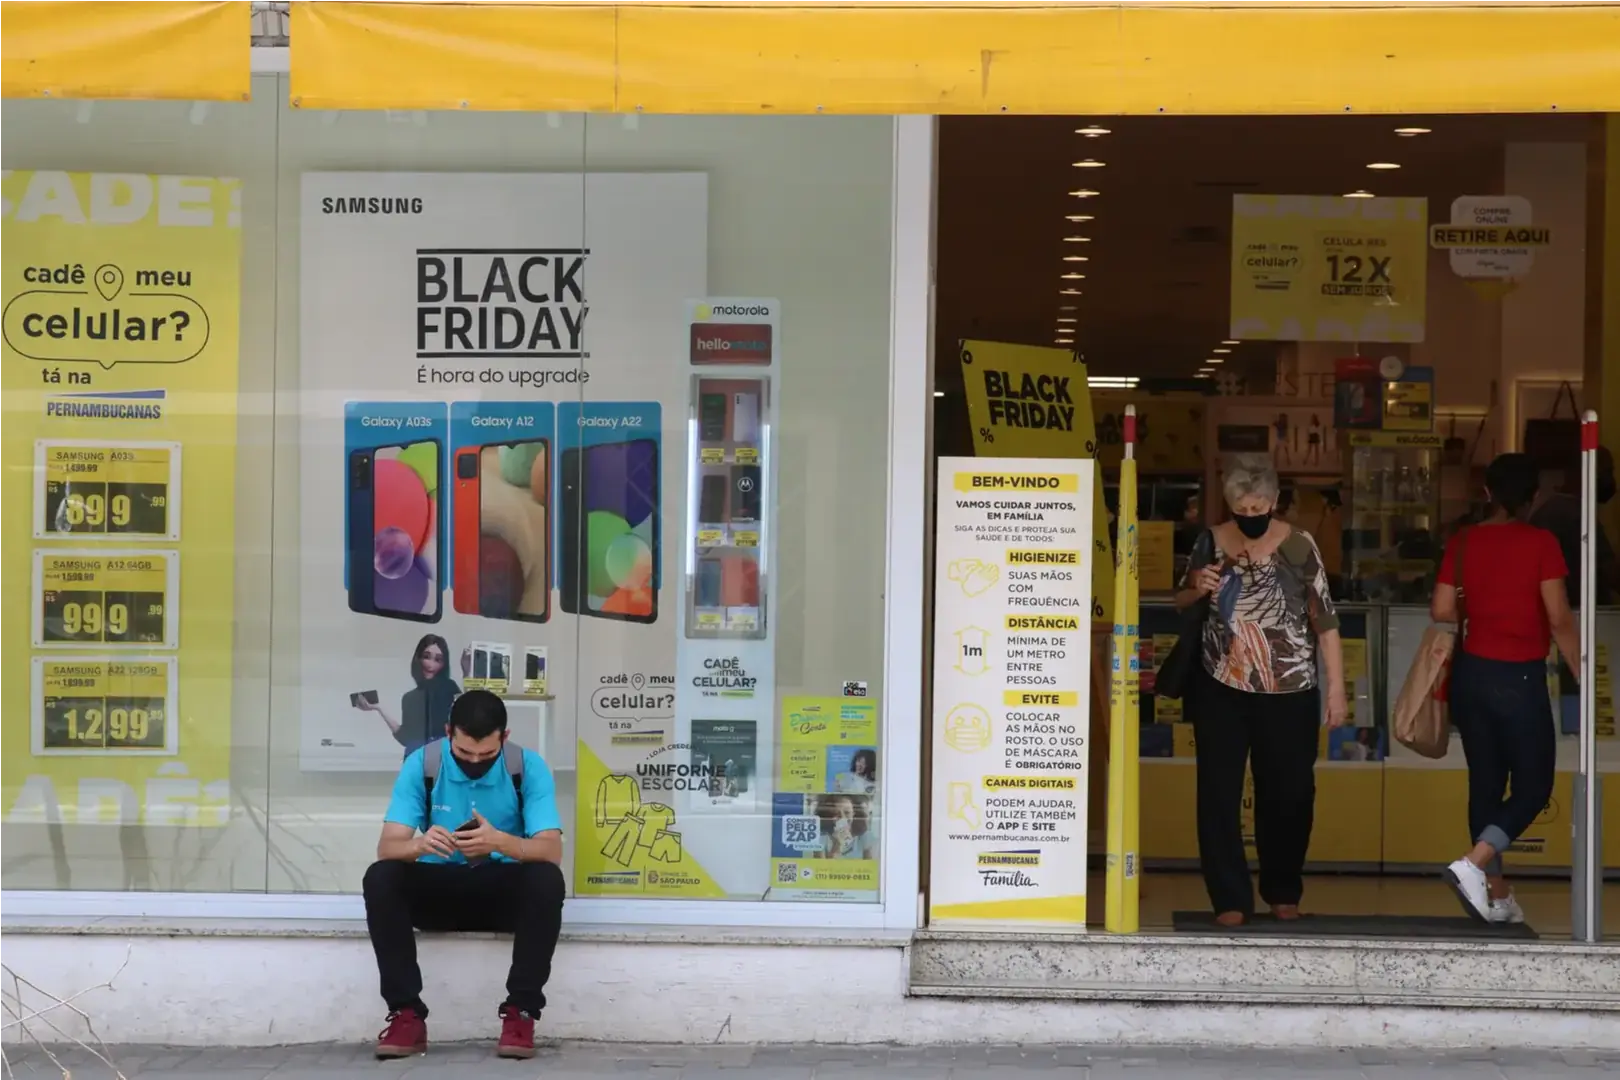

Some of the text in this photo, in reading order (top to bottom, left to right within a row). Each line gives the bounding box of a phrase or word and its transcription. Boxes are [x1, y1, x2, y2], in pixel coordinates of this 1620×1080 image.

[322, 197, 423, 214] SAMSUNG
[1476, 216, 1508, 224] ONLINE
[1435, 229, 1550, 243] RETIRE AQUI
[1247, 256, 1298, 268] celular?
[24, 264, 192, 286] cadê meu
[417, 256, 588, 303] BLACK
[1324, 285, 1346, 294] SEM
[713, 305, 769, 316] motorola
[23, 307, 190, 341] celular?
[417, 306, 590, 350] FRIDAY
[42, 368, 91, 384] tá na
[417, 365, 590, 387] É hora do upgrade
[983, 370, 1073, 404] BLACK
[47, 402, 161, 419] PERNAMBUCANAS
[988, 399, 1075, 432] FRIDAY
[361, 416, 432, 429] Galaxy A03s
[471, 416, 534, 429] Galaxy A12
[577, 416, 642, 430] Galaxy A22
[56, 452, 134, 461] SAMSUNG A03S
[972, 476, 1060, 488] BEM-VINDO
[956, 501, 1076, 511] VAMOS CUIDAR JUNTOS,
[987, 511, 1044, 521] EM FAMÍLIA
[975, 533, 1002, 541] SAÚDE
[1009, 552, 1076, 563] HIGIENIZE
[53, 561, 152, 569] SAMSUNG A12 64GB
[1008, 570, 1072, 580] SUAS MÃOS
[1008, 584, 1033, 592] COM
[1008, 596, 1080, 607] FREQUÊNCIA
[1008, 616, 1077, 629] DISTÂNCIA
[1007, 635, 1066, 646] MÍNIMA DE
[962, 644, 983, 656] 1m
[1007, 649, 1065, 659] UM METRO
[703, 656, 739, 669] CADÊ
[1006, 663, 1043, 671] ENTRE
[54, 666, 101, 674] SAMSUNG
[108, 666, 125, 674] A22
[720, 669, 746, 677] meu
[600, 673, 675, 684] cadê meu
[692, 677, 757, 688] CELULAR?
[1006, 676, 1056, 685] PESSOAS
[600, 693, 675, 709] celular?
[1022, 694, 1060, 704] EVITE
[1005, 712, 1060, 721] COLOCAR
[609, 721, 618, 729] tá
[1005, 723, 1076, 734] AS MÃOS NO
[1005, 736, 1084, 746] ROSTO. O USO
[649, 746, 666, 758] LOJA
[1005, 747, 1078, 758] DE MÁSCARA
[1005, 759, 1082, 770] É OBRIGATÓRIO
[636, 764, 727, 777] UNIFORME
[642, 778, 721, 791] ESCOLAR
[986, 779, 1073, 788] CANAIS DIGITAIS
[986, 799, 1076, 809] PODEM AJUDAR,
[986, 810, 1076, 820] UTILIZE TAMBÉM
[786, 824, 817, 832] PELO
[986, 822, 1056, 831] O APP E SITE
[786, 832, 817, 842] ZAP
[948, 833, 1069, 842] www.pernambucanas.com.br
[979, 856, 1039, 865] PERNAMBUCANAS
[660, 876, 675, 884] SÃO
[978, 870, 1039, 887] Família
